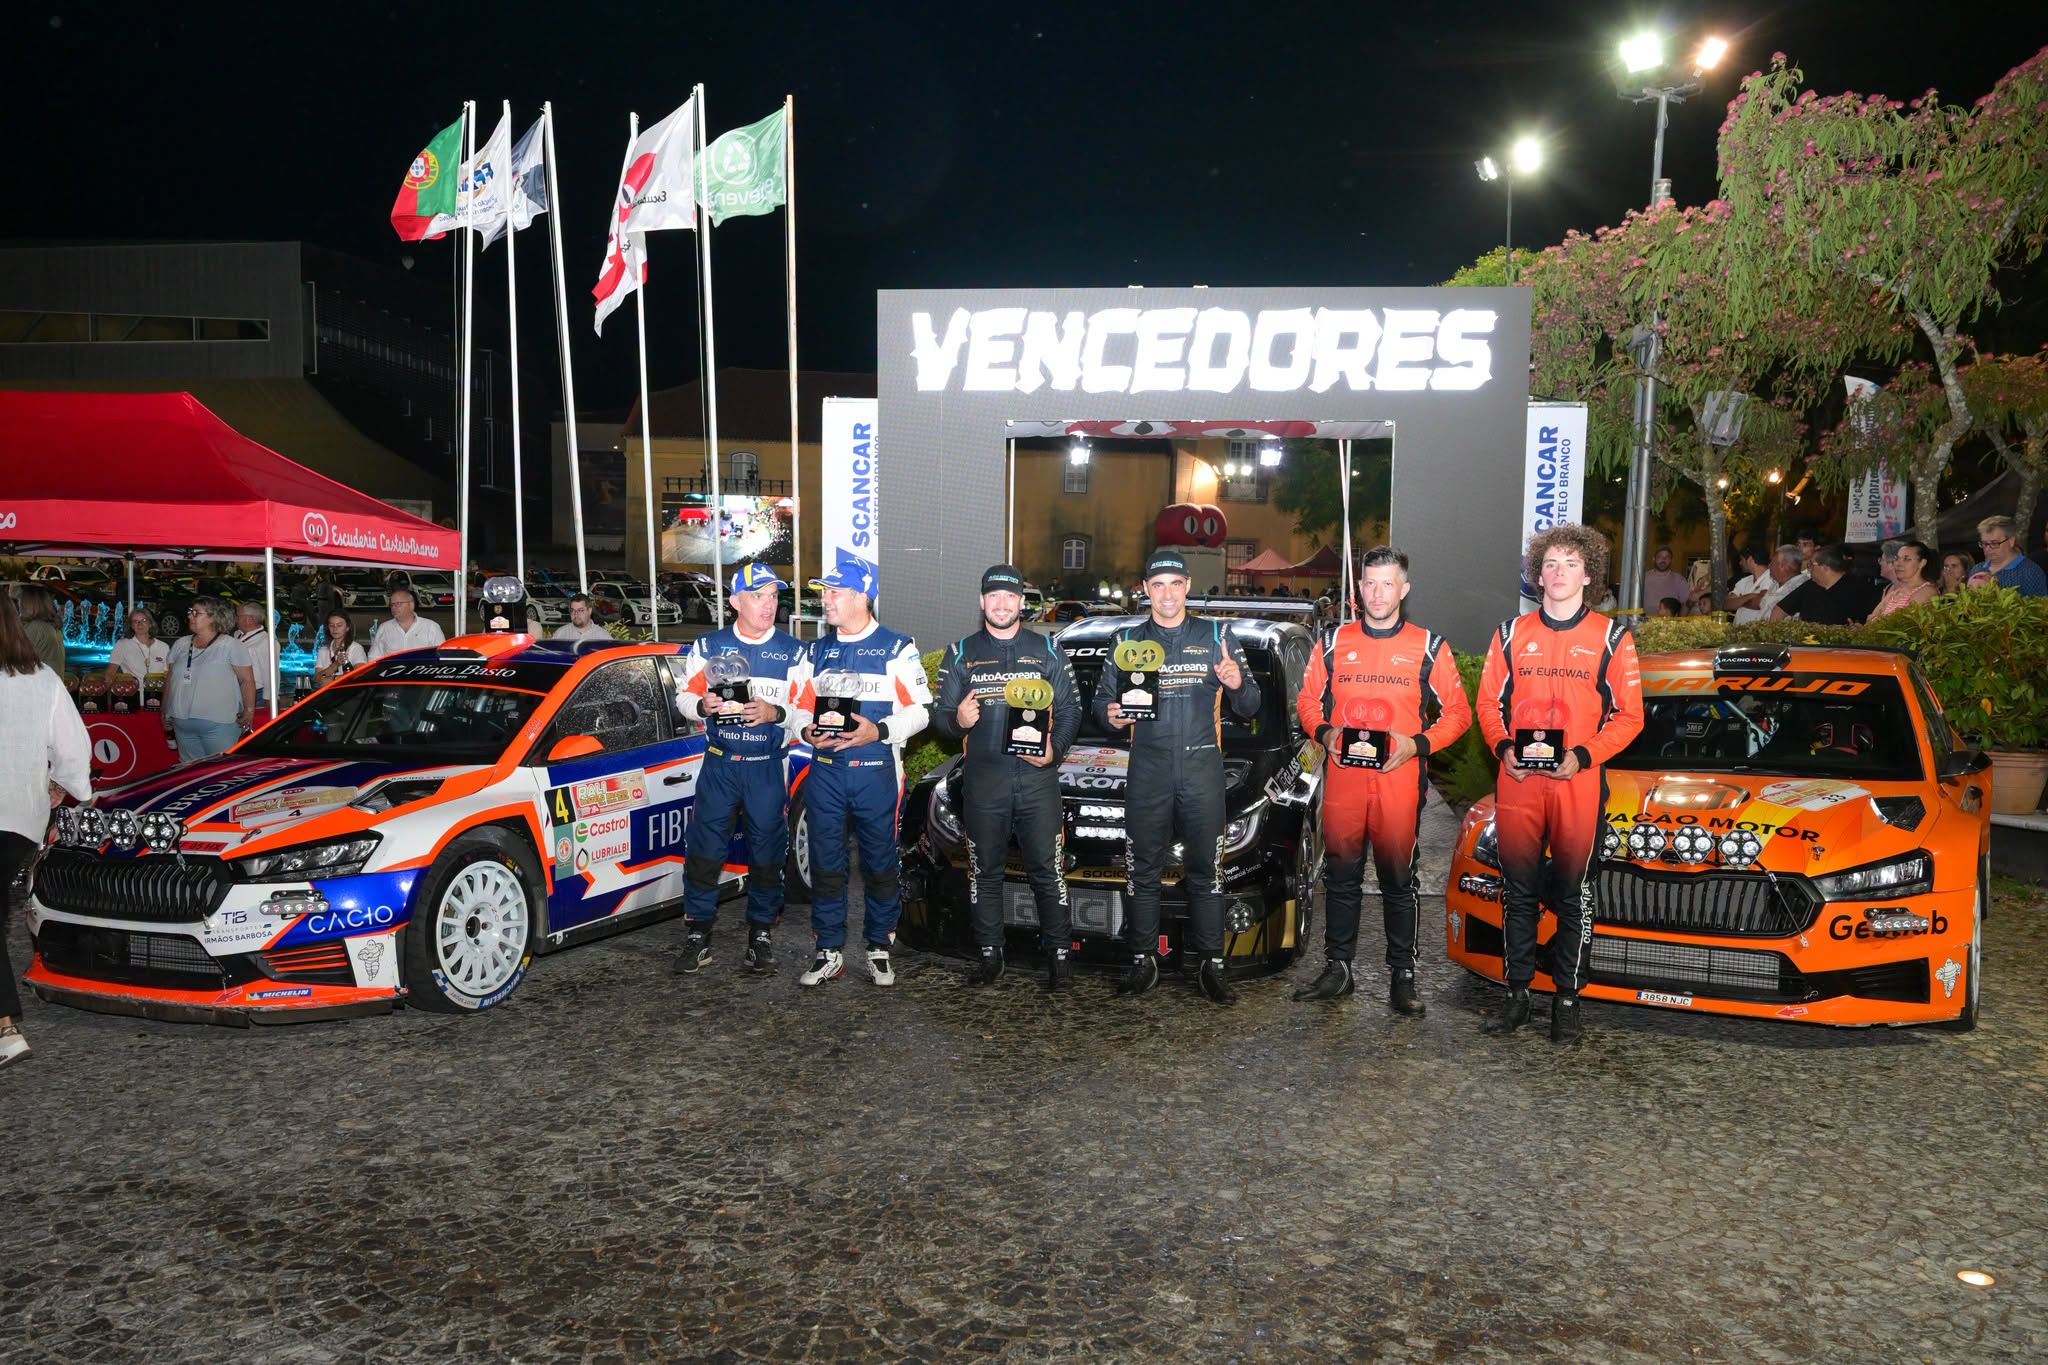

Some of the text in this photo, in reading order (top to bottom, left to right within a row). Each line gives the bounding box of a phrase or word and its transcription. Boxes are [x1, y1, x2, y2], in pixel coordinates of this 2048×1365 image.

[910, 305, 1498, 395] VENCEDORES
[852, 422, 871, 548] SCANCAR
[1534, 425, 1559, 536] CANCAR
[1557, 438, 1571, 527] STELO BRANCO
[331, 525, 377, 549] Escuderia
[405, 665, 517, 678] Pinto Basto
[1536, 667, 1591, 680] EUROWAG
[1355, 674, 1411, 687] EUROWAG
[718, 728, 768, 742] Pinto Basto
[1085, 766, 1107, 774] 69
[578, 780, 607, 799] RALI
[555, 788, 570, 823] 4
[1821, 794, 1847, 803] 33
[288, 809, 304, 817] 4
[590, 815, 629, 837] Castrol
[1708, 816, 1820, 842] MOTOR
[591, 841, 630, 861] LUBRIALBI
[221, 911, 248, 925] TIB
[308, 905, 394, 934] CACIO
[204, 930, 273, 944] IRMÃOS BARBOSA
[261, 988, 309, 998] MICHELIN
[1643, 993, 1690, 1006] 3858 NJC
